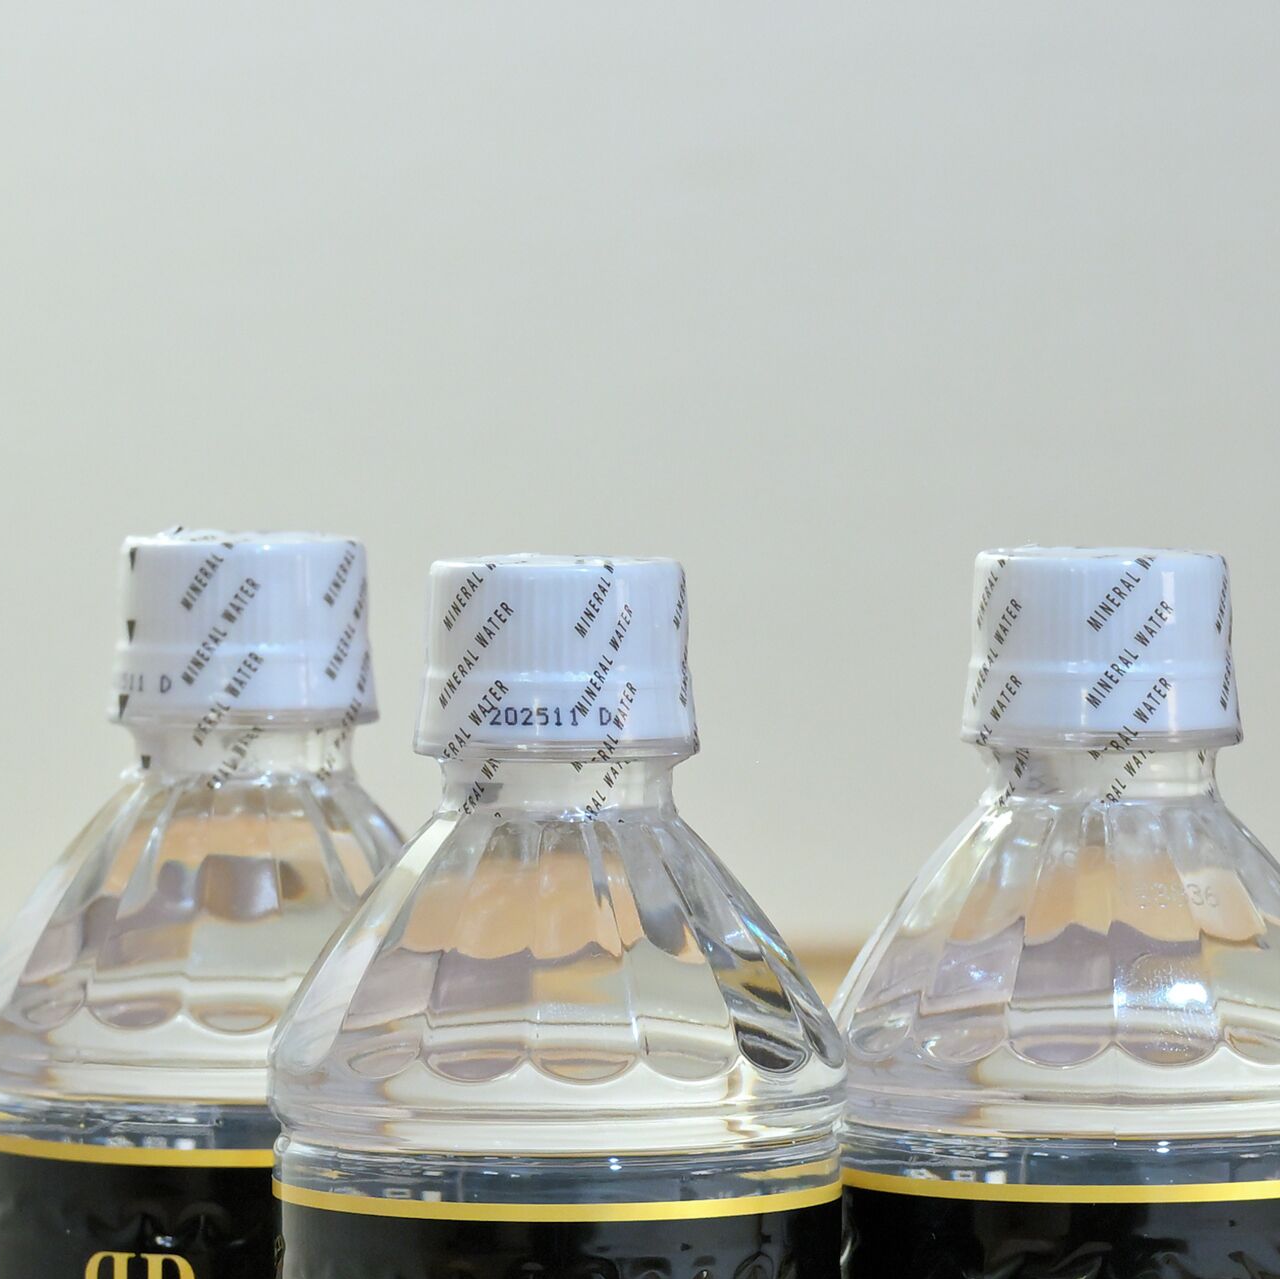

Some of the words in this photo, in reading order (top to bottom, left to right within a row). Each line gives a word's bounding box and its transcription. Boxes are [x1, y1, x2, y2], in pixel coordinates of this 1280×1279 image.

[180, 553, 224, 612] MINERAL
[323, 550, 355, 607] MINERAL
[443, 571, 484, 632] MINERAL
[574, 576, 611, 639] MINERAL
[977, 570, 999, 630] MINERAL
[1086, 571, 1141, 632] MINERAL
[181, 626, 228, 687] MINERAL
[221, 576, 261, 624] WATER
[324, 624, 356, 681] MINERAL
[439, 649, 479, 710] MINERAL
[474, 601, 514, 648] WATER
[575, 654, 613, 718] MINERAL
[609, 603, 633, 652] WATER
[972, 647, 999, 707] MINERAL
[994, 598, 1023, 645] WATER
[1085, 648, 1139, 709] MINERAL
[1134, 599, 1174, 647] WATER
[224, 651, 264, 698] WATER
[990, 674, 1023, 722] WATER
[1133, 676, 1173, 724] WATER
[442, 727, 471, 760] ERAL
[468, 679, 510, 726] WATER
[489, 707, 579, 726] 202511
[599, 707, 612, 726] D
[613, 681, 637, 731] WATER
